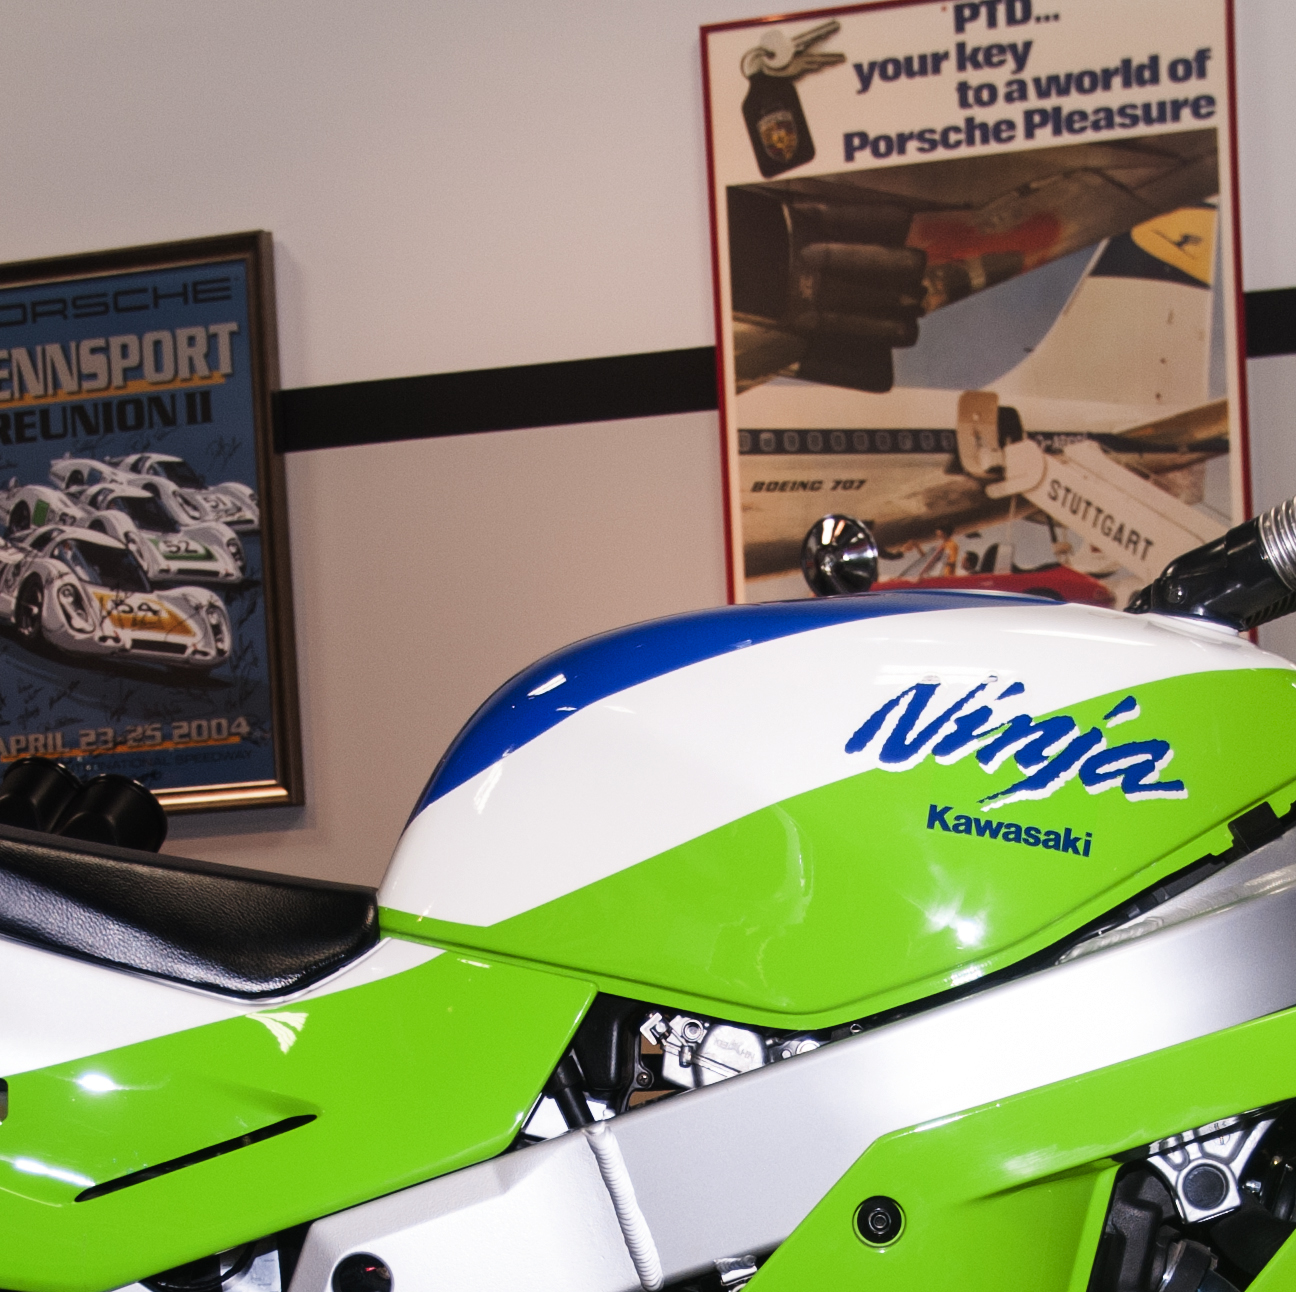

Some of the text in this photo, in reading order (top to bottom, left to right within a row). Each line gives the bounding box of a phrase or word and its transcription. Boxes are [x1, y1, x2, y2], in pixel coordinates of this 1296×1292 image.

[853, 40, 1033, 94] your key
[956, 47, 1213, 109] to a world of
[844, 115, 1017, 162] Porsche
[1022, 94, 1216, 140] Pleasure
[185, 390, 213, 424] II
[750, 478, 867, 493] BOEING 707
[1046, 478, 1156, 561] STUTTGART
[161, 540, 198, 555] 52
[79, 722, 163, 750] 23-25
[172, 716, 251, 743] 2004
[845, 675, 1187, 809] Ninja
[926, 803, 1092, 858] Kawasaki
